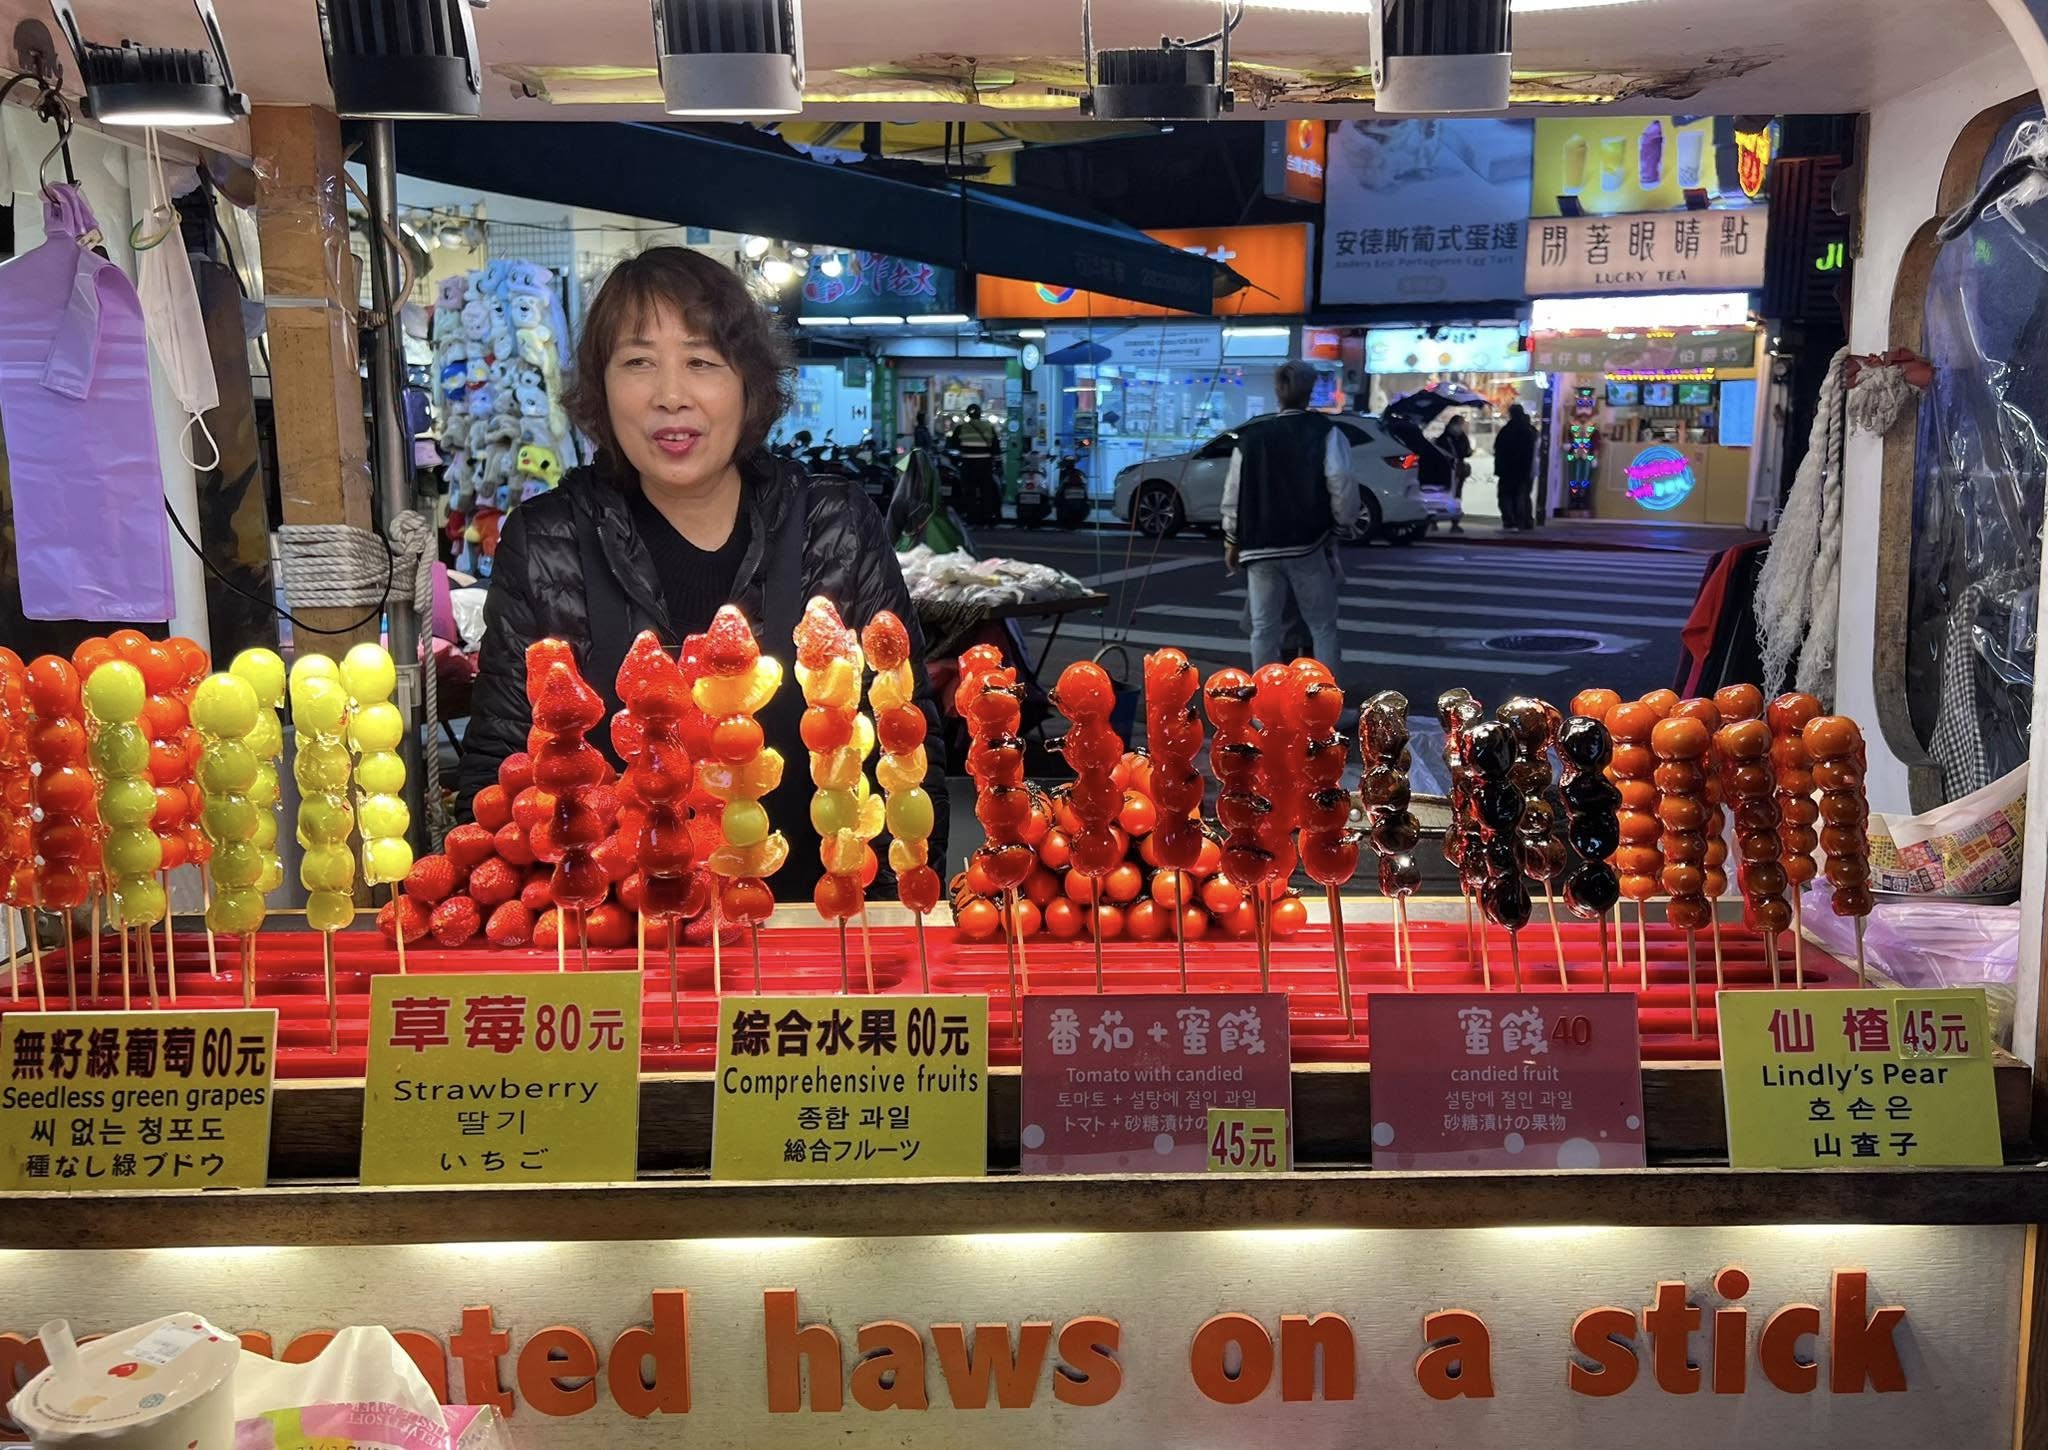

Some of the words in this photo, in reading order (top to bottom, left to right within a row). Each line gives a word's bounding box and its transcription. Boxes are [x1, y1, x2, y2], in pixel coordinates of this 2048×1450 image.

[1336, 222, 1518, 256] 安德斯葡式蛋撻
[1541, 215, 1749, 267] 閉著眼睛點
[1595, 272, 1644, 284] LUCKY
[1658, 271, 1687, 282] TEA
[1458, 1006, 1549, 1055] 蜜餞
[1551, 1015, 1593, 1046] 40
[1903, 1010, 1969, 1054] 45元
[723, 1065, 905, 1101] Comprehensive
[917, 1064, 978, 1092] fruits
[1066, 1067, 1130, 1083] Tomato
[1134, 1066, 1172, 1082] with
[1176, 1066, 1243, 1082] candied
[1451, 1065, 1517, 1082] candied
[1522, 1065, 1559, 1082] fruit
[1883, 1063, 1949, 1085] Pear
[3, 1086, 104, 1109] Seedless
[112, 1087, 178, 1113] green
[186, 1087, 265, 1111] grapes
[394, 1077, 598, 1103] Strawberry
[1056, 1091, 1106, 1108] 토마토
[1130, 1091, 1179, 1110] 설탕에
[1185, 1090, 1217, 1109] 절인
[1225, 1090, 1257, 1109] 과일
[1445, 1090, 1495, 1110] 설탕에
[1501, 1090, 1533, 1110] 절인
[1540, 1090, 1574, 1110] 과일
[457, 1110, 525, 1136] 딸기
[798, 1106, 849, 1130] 종합
[859, 1105, 910, 1130] 과일
[1125, 1115, 1209, 1133] 砂糖漬けの
[30, 1118, 55, 1146] 씨
[71, 1117, 126, 1146] 없는
[138, 1116, 225, 1145] 청포도
[1211, 1121, 1277, 1168] 45元
[441, 1148, 549, 1171] いちご
[764, 1288, 1123, 1413] haws
[1191, 1311, 1356, 1405] on
[1415, 1308, 1495, 1400] a
[1568, 1267, 1908, 1397] stick
